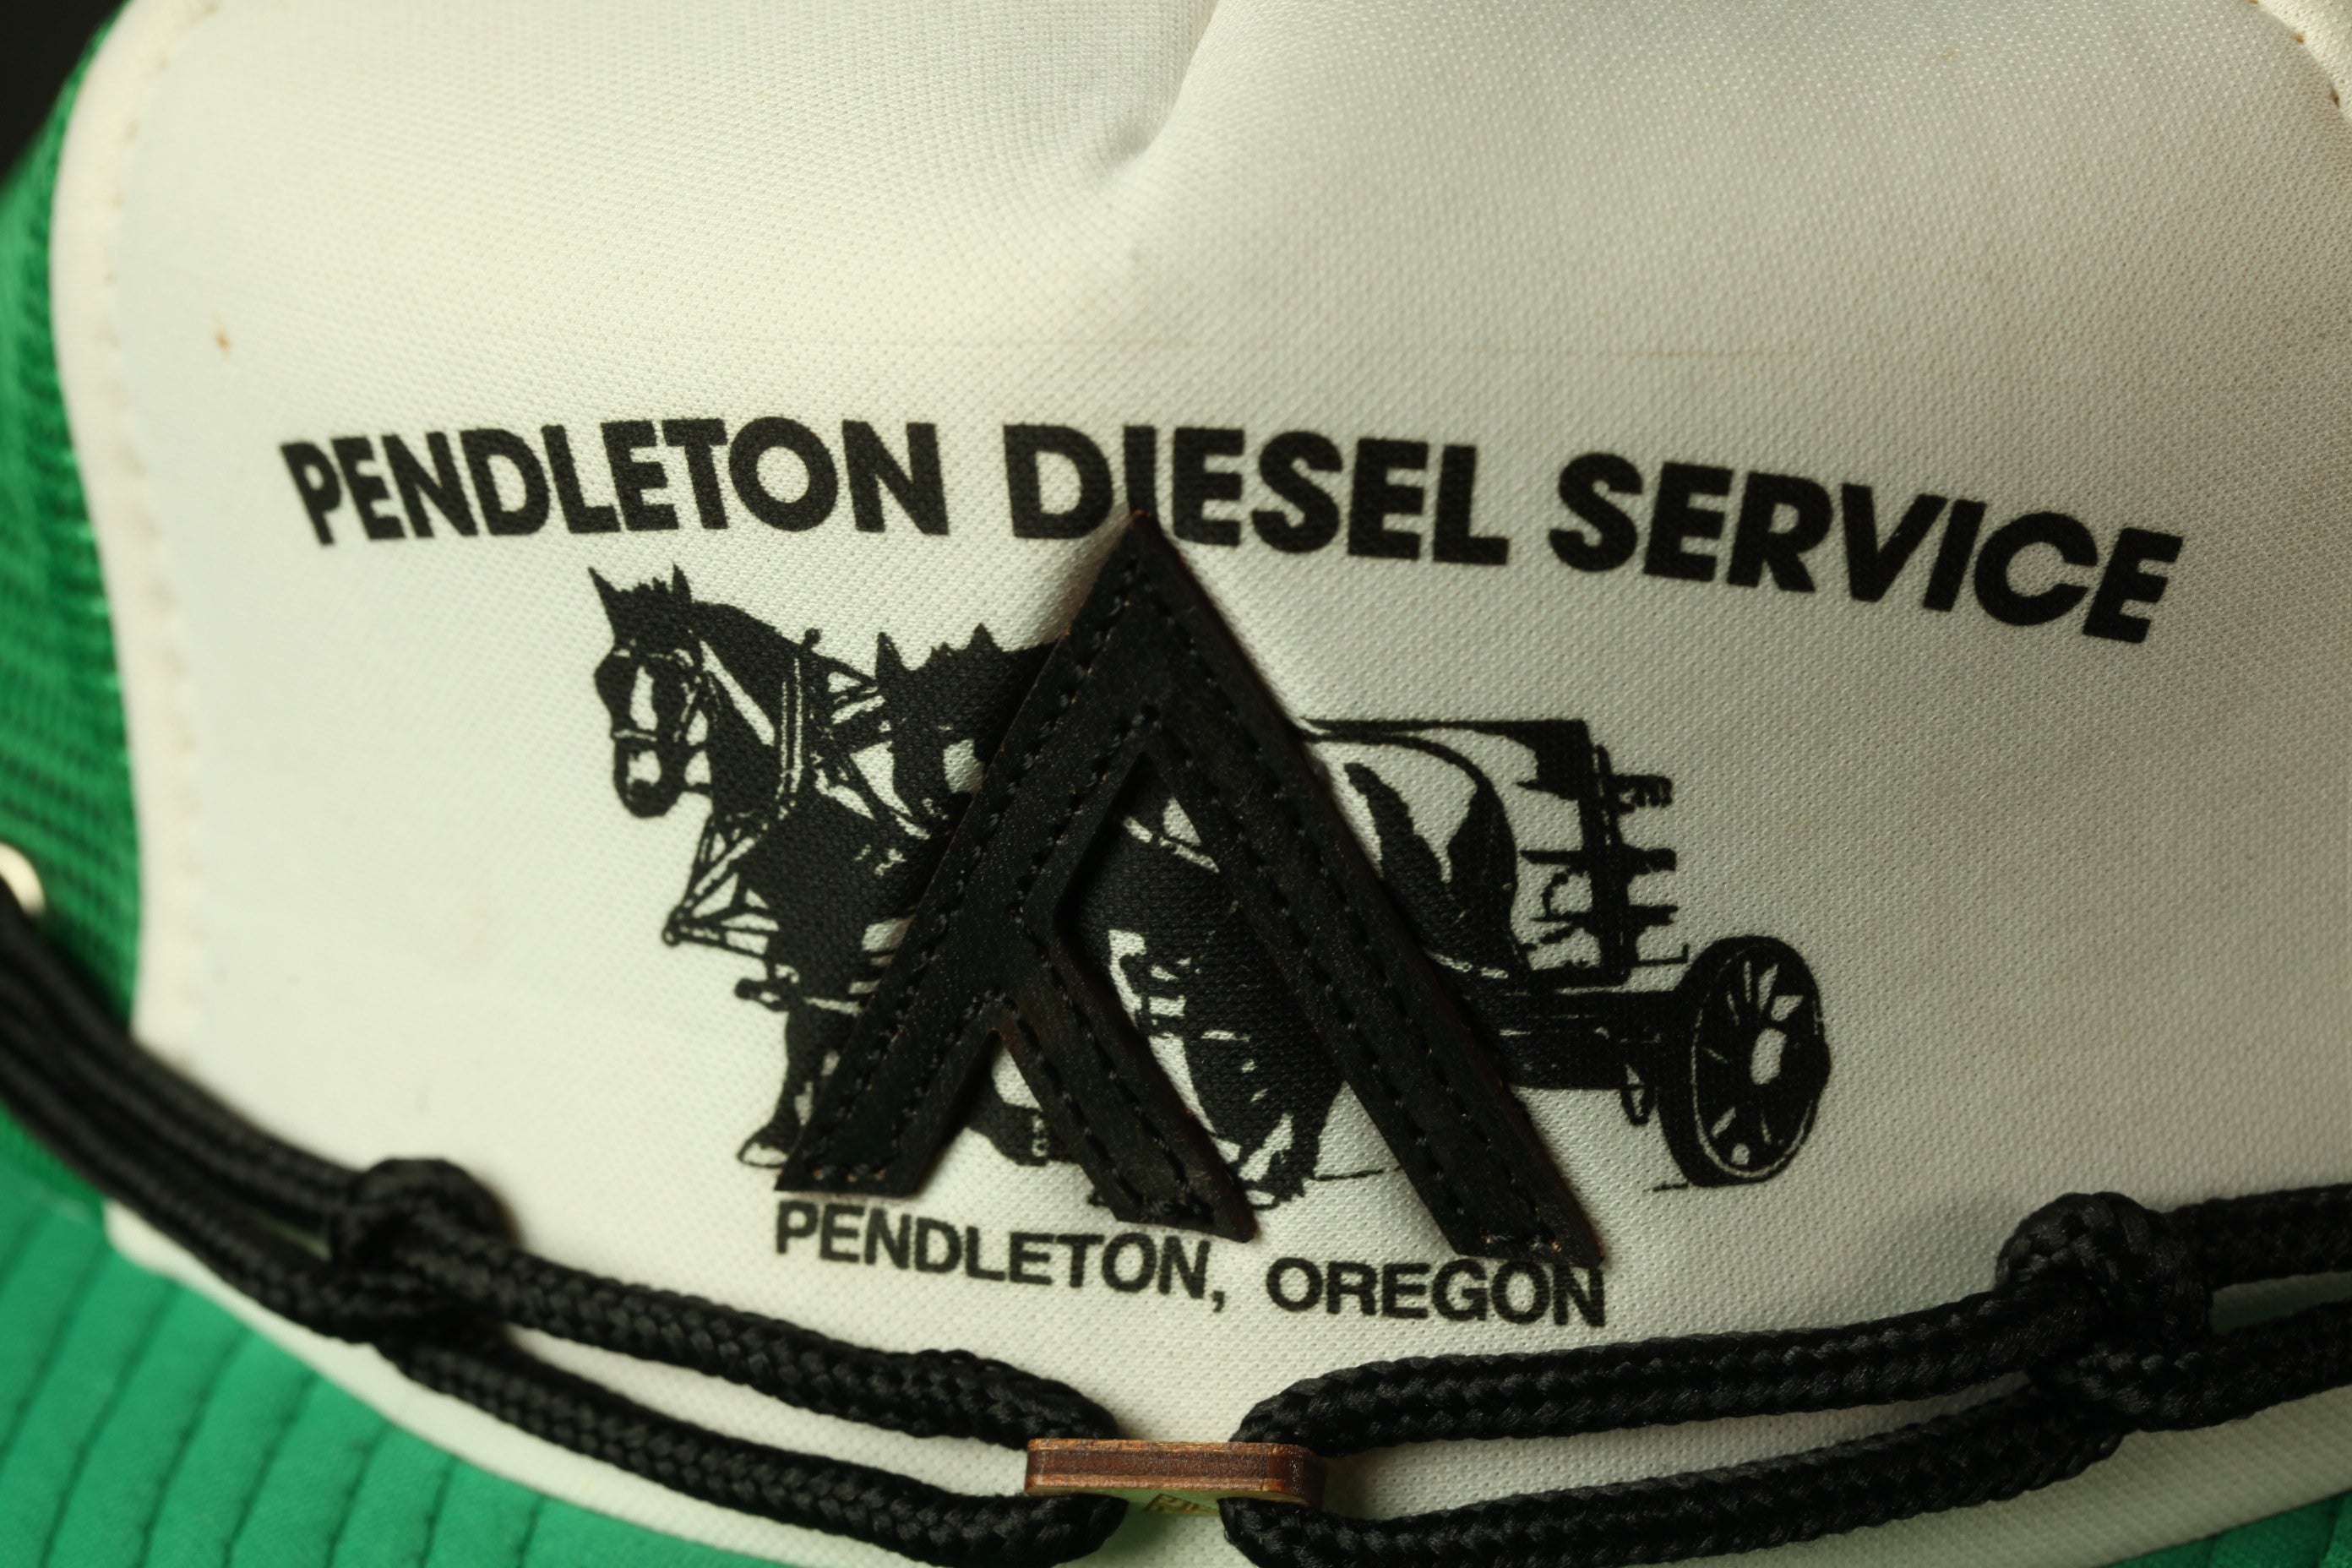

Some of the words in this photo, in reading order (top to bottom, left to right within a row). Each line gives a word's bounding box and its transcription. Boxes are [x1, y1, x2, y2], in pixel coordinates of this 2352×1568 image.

[280, 416, 950, 546] PENDLETON
[1003, 423, 1510, 566] DIESEL
[1548, 452, 2186, 645] SERVICE
[776, 1200, 1225, 1314] PENDLETON,
[1266, 1256, 1606, 1328] OREGON
